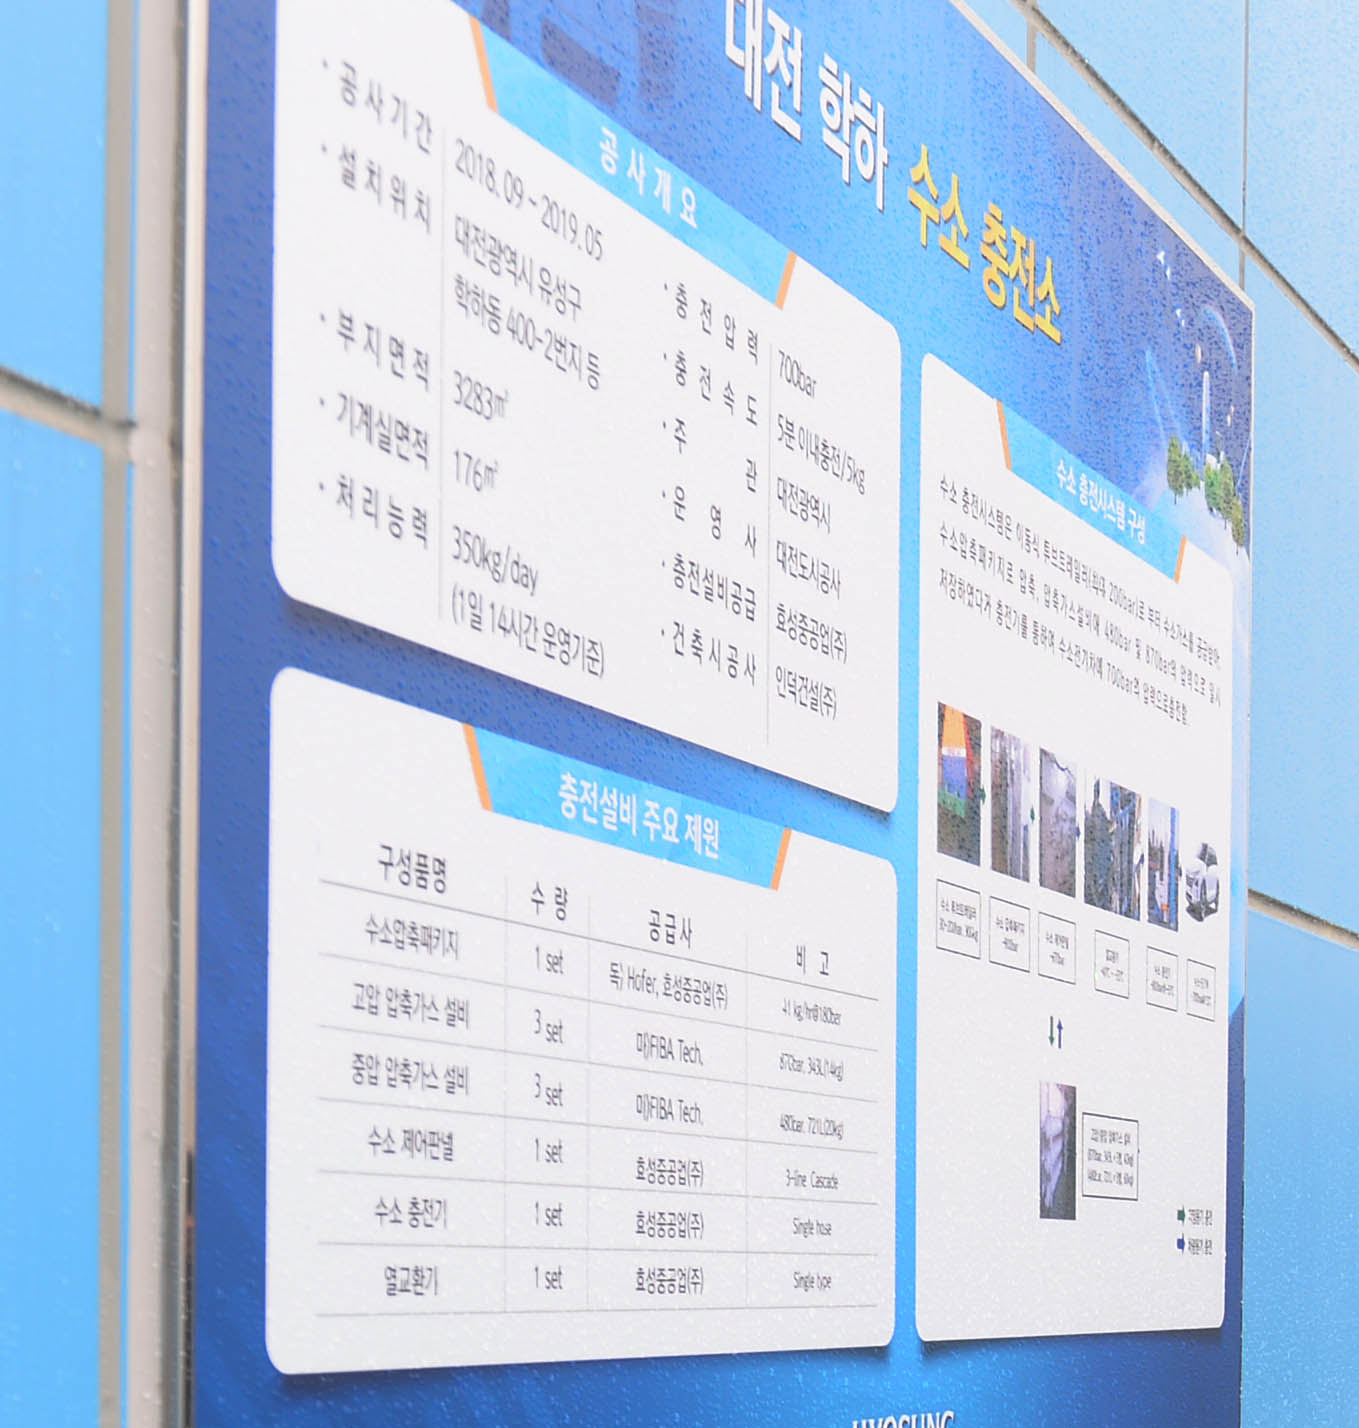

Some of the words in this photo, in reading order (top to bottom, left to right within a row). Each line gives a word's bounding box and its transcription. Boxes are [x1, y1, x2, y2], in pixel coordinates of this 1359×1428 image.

[725, 0, 802, 144] 대전
[819, 52, 889, 213] 학하
[908, 143, 971, 271] 수소
[980, 201, 1063, 346] 충전소
[455, 217, 534, 296] 대전광역시
[538, 267, 583, 322] 유성구
[455, 275, 501, 336] 학하동
[778, 350, 816, 398] 700bar
[337, 393, 430, 471] 기계실면적
[778, 413, 794, 452] 5분
[777, 477, 831, 534] 대전광역시
[1056, 458, 1077, 495] 수소
[940, 474, 957, 504] 수소
[962, 487, 1012, 541] 충전시스템은
[452, 525, 539, 597] 350kg/day
[673, 553, 757, 622] 충전설비공급
[776, 540, 841, 600] 대전도시공사
[452, 582, 484, 632] (1일
[489, 601, 539, 653] 14시간
[543, 621, 604, 680] 운영기준)
[776, 603, 848, 664] 효성중공업(주)
[559, 772, 638, 835] 충전설비
[643, 799, 680, 845] 주요
[684, 812, 720, 859] 제원
[378, 844, 446, 894] 구성품명
[649, 909, 692, 949] 공급사
[365, 913, 458, 961] 수소압축패키지
[546, 950, 564, 974] set
[352, 982, 380, 1016] 고압
[385, 987, 439, 1023] 압축가스
[444, 998, 470, 1029] 설비
[534, 1008, 541, 1034] 3
[546, 1019, 564, 1043] set
[352, 1052, 380, 1086] 중압
[385, 1055, 439, 1091] 압축가스
[444, 1063, 470, 1096] 설비
[534, 1073, 541, 1098] 3
[546, 1082, 564, 1106] set
[368, 1125, 396, 1157] 수소
[545, 1139, 563, 1163] set
[635, 1156, 703, 1187] 효성중공업(주)
[374, 1196, 402, 1228] 수소
[407, 1196, 448, 1229] 충전기
[545, 1202, 563, 1227] set
[635, 1211, 703, 1239] 효성중공업(주)
[384, 1265, 438, 1296] 열교환기
[545, 1265, 563, 1290] set
[635, 1267, 703, 1294] 효성중공업(주)
